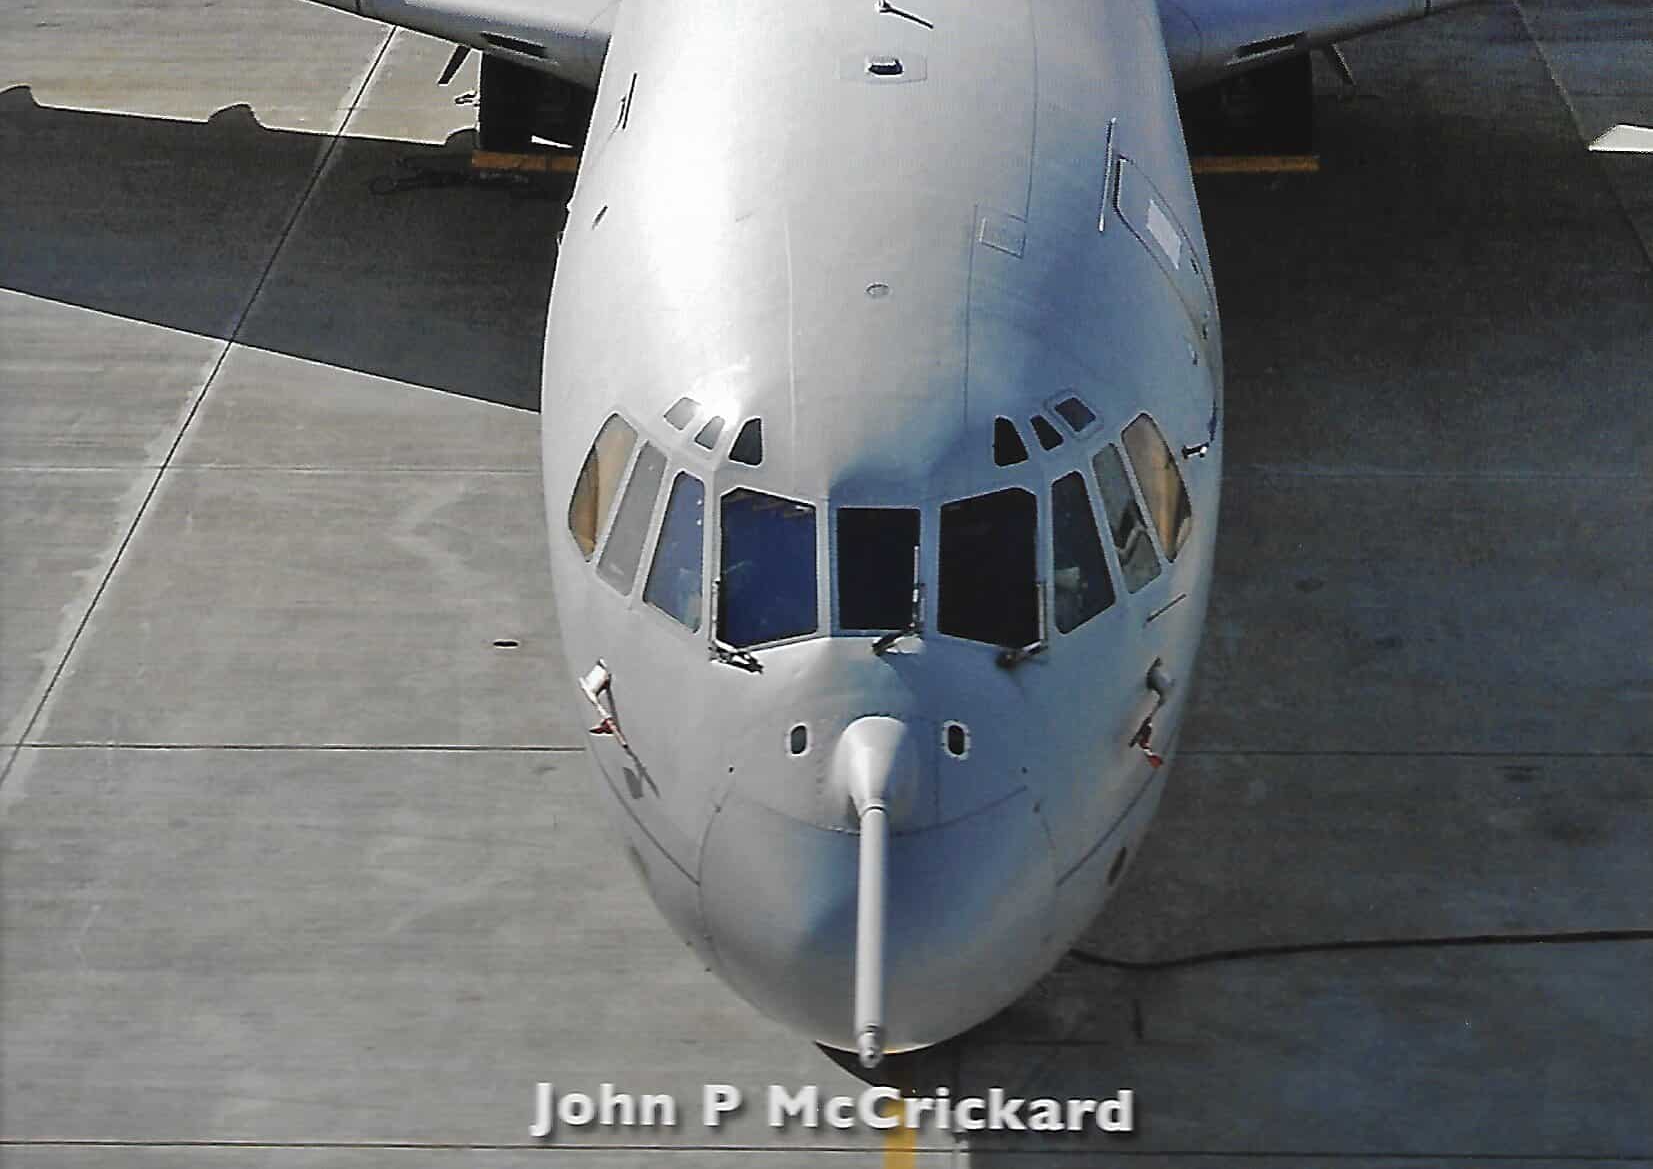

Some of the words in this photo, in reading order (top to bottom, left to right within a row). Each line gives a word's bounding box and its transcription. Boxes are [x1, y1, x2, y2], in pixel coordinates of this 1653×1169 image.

[529, 1082, 677, 1137] John
[702, 1084, 742, 1127] P
[766, 1084, 1134, 1132] McCrickard
